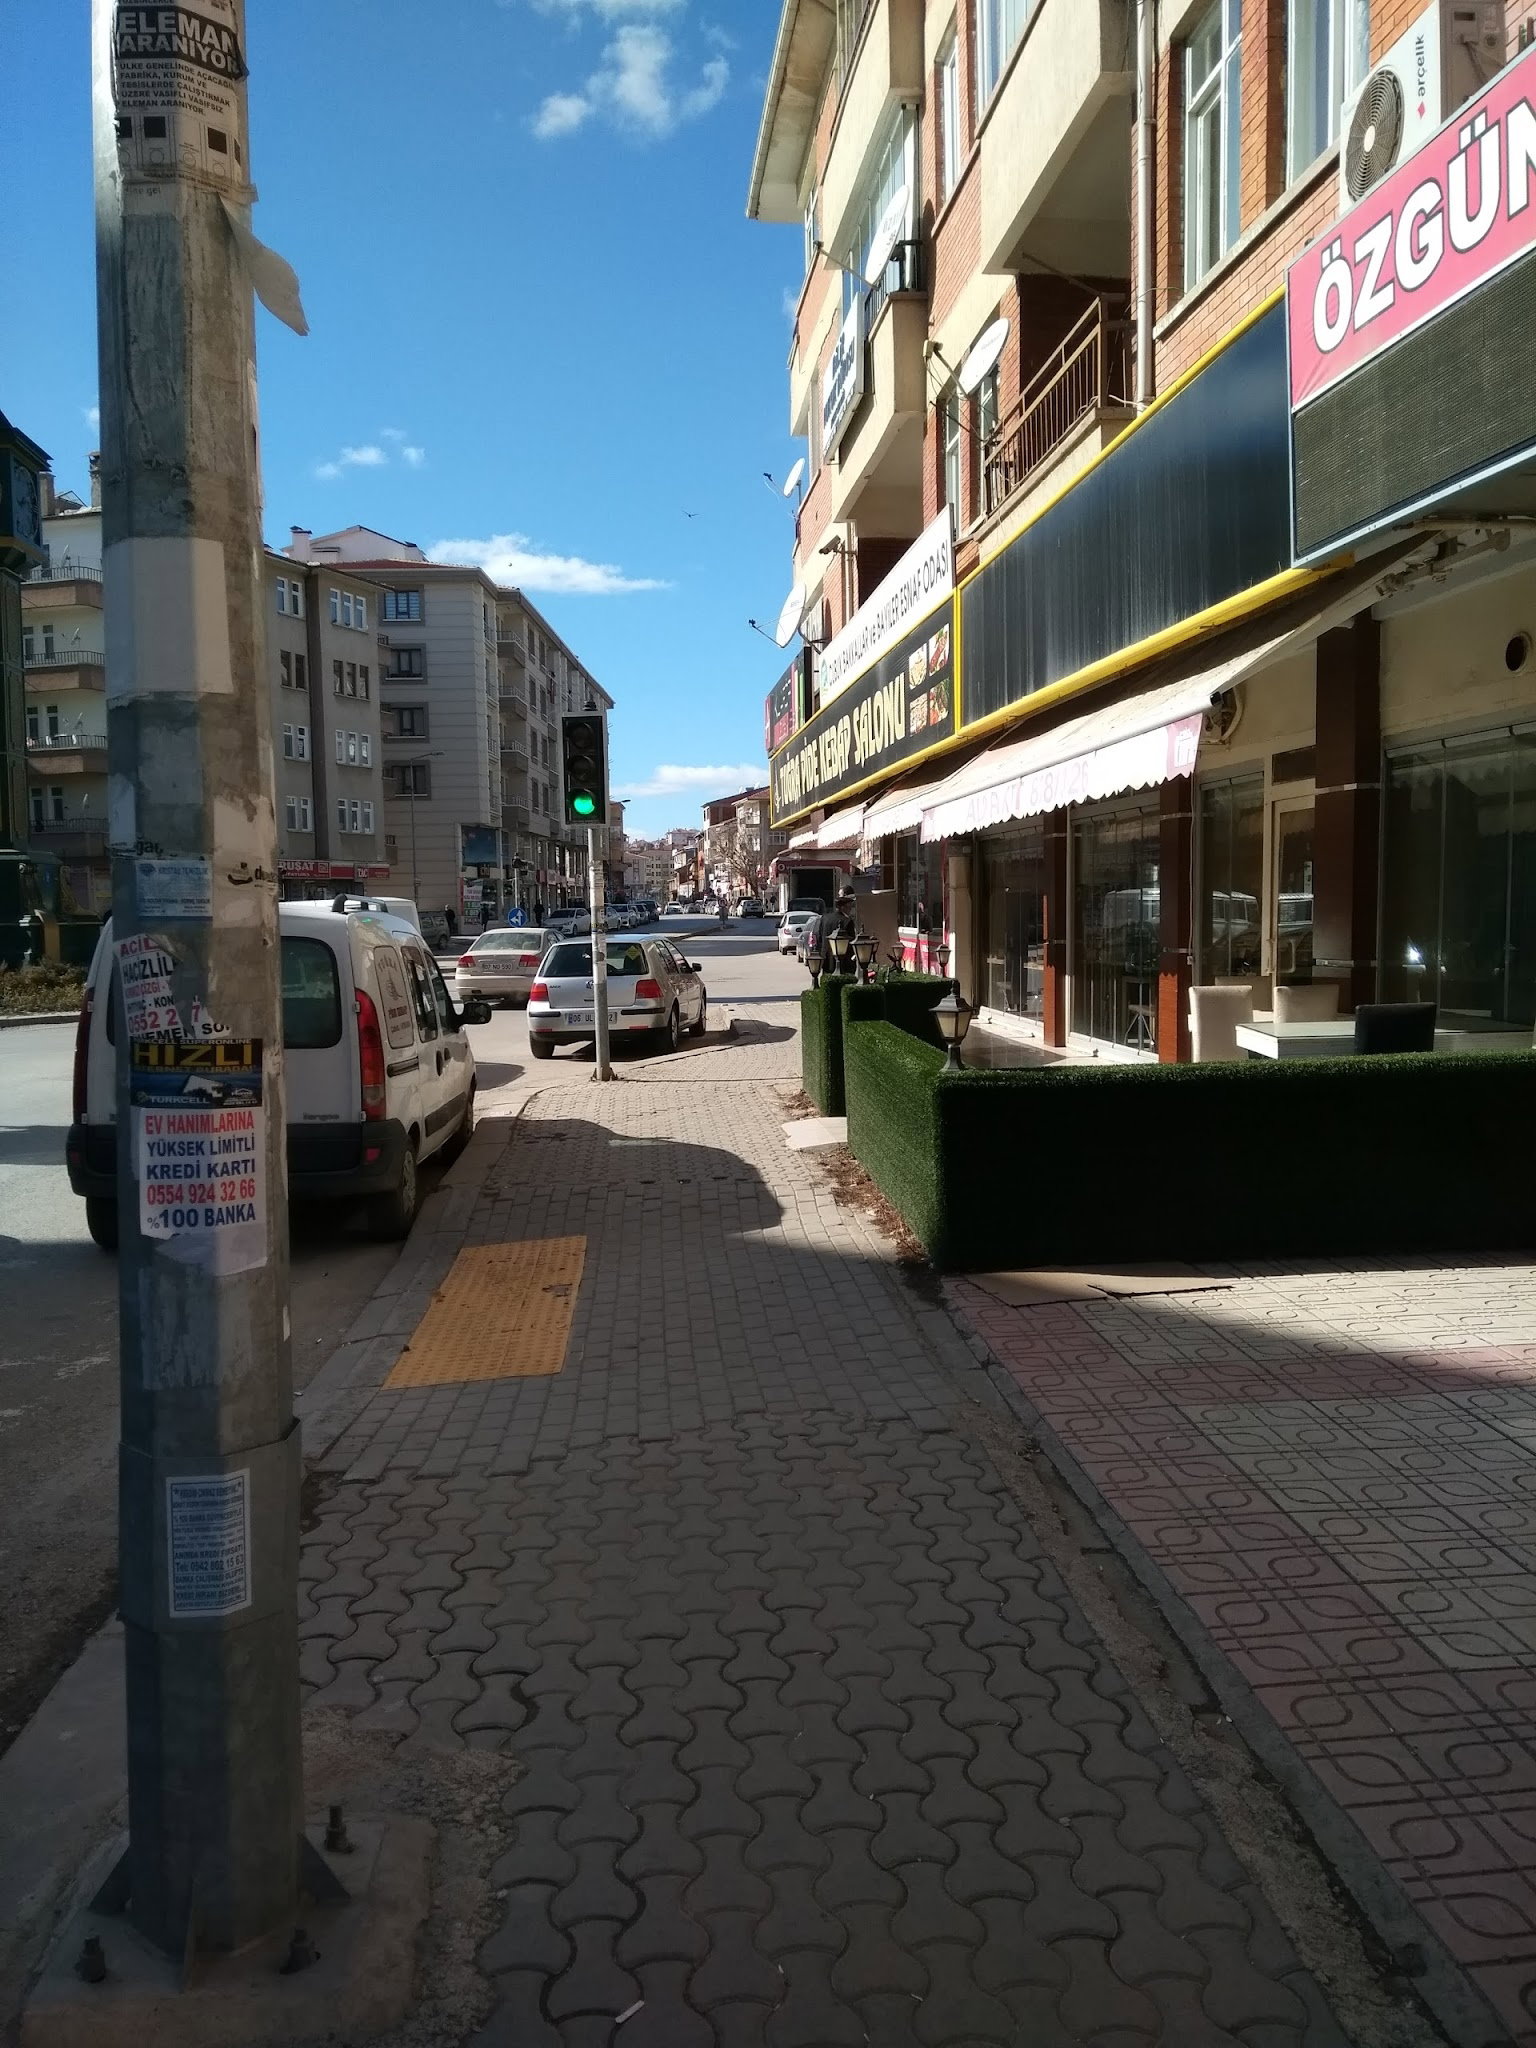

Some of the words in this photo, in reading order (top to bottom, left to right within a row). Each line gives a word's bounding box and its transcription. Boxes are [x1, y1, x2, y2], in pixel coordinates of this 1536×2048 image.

[119, 11, 237, 56] ELEMAN
[120, 34, 240, 73] ARANIYOR
[1415, 32, 1426, 97] arçelik
[163, 72, 194, 84] KURUM
[900, 568, 921, 616] ESNAF
[923, 539, 949, 593] ODASI
[801, 736, 820, 795] PİDE
[819, 714, 851, 783] KEBAP
[853, 672, 906, 768] SALONU
[120, 936, 160, 957] ACİL
[134, 1043, 253, 1066] HIZLI
[145, 1114, 163, 1135] EV
[167, 1111, 254, 1135] HANIMLARINA
[147, 1139, 205, 1157] YÜKSEK
[210, 1132, 255, 1156] LİMİTLİ
[147, 1160, 201, 1180] KREDİ
[207, 1158, 256, 1178] KARTI
[147, 1184, 183, 1205] 0554
[189, 1183, 216, 1204] 924
[220, 1182, 236, 1202] 32
[239, 1178, 256, 1199] 66
[147, 1208, 199, 1229] %100
[204, 1203, 256, 1227] BANKA
